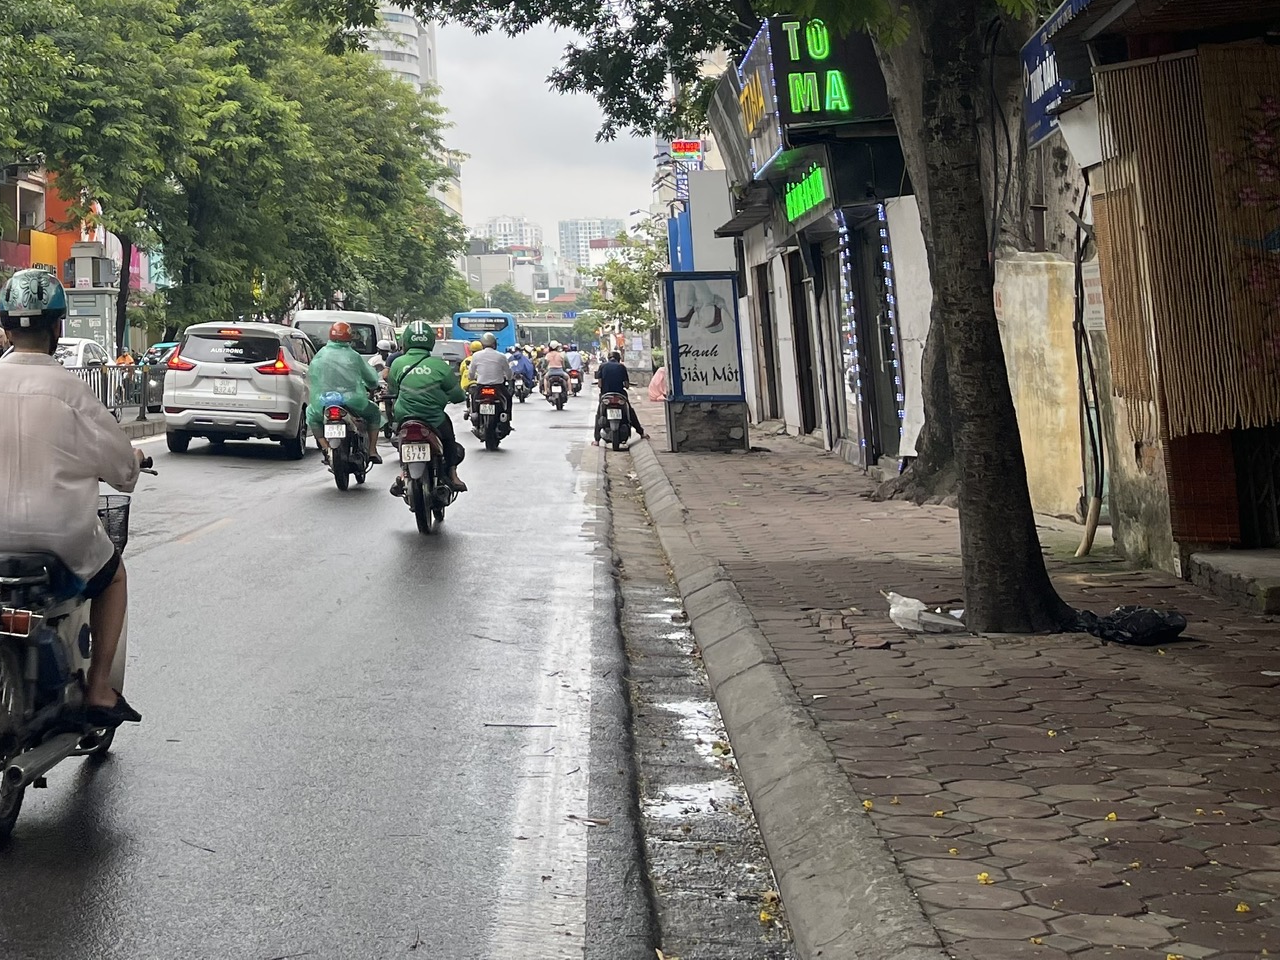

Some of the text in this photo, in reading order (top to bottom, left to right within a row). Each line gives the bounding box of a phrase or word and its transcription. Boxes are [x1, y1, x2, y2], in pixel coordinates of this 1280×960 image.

[782, 19, 830, 61] TO
[787, 69, 850, 113] MA
[679, 343, 719, 361] Hạnh
[402, 365, 432, 375] Grab
[712, 362, 739, 382] Mốt
